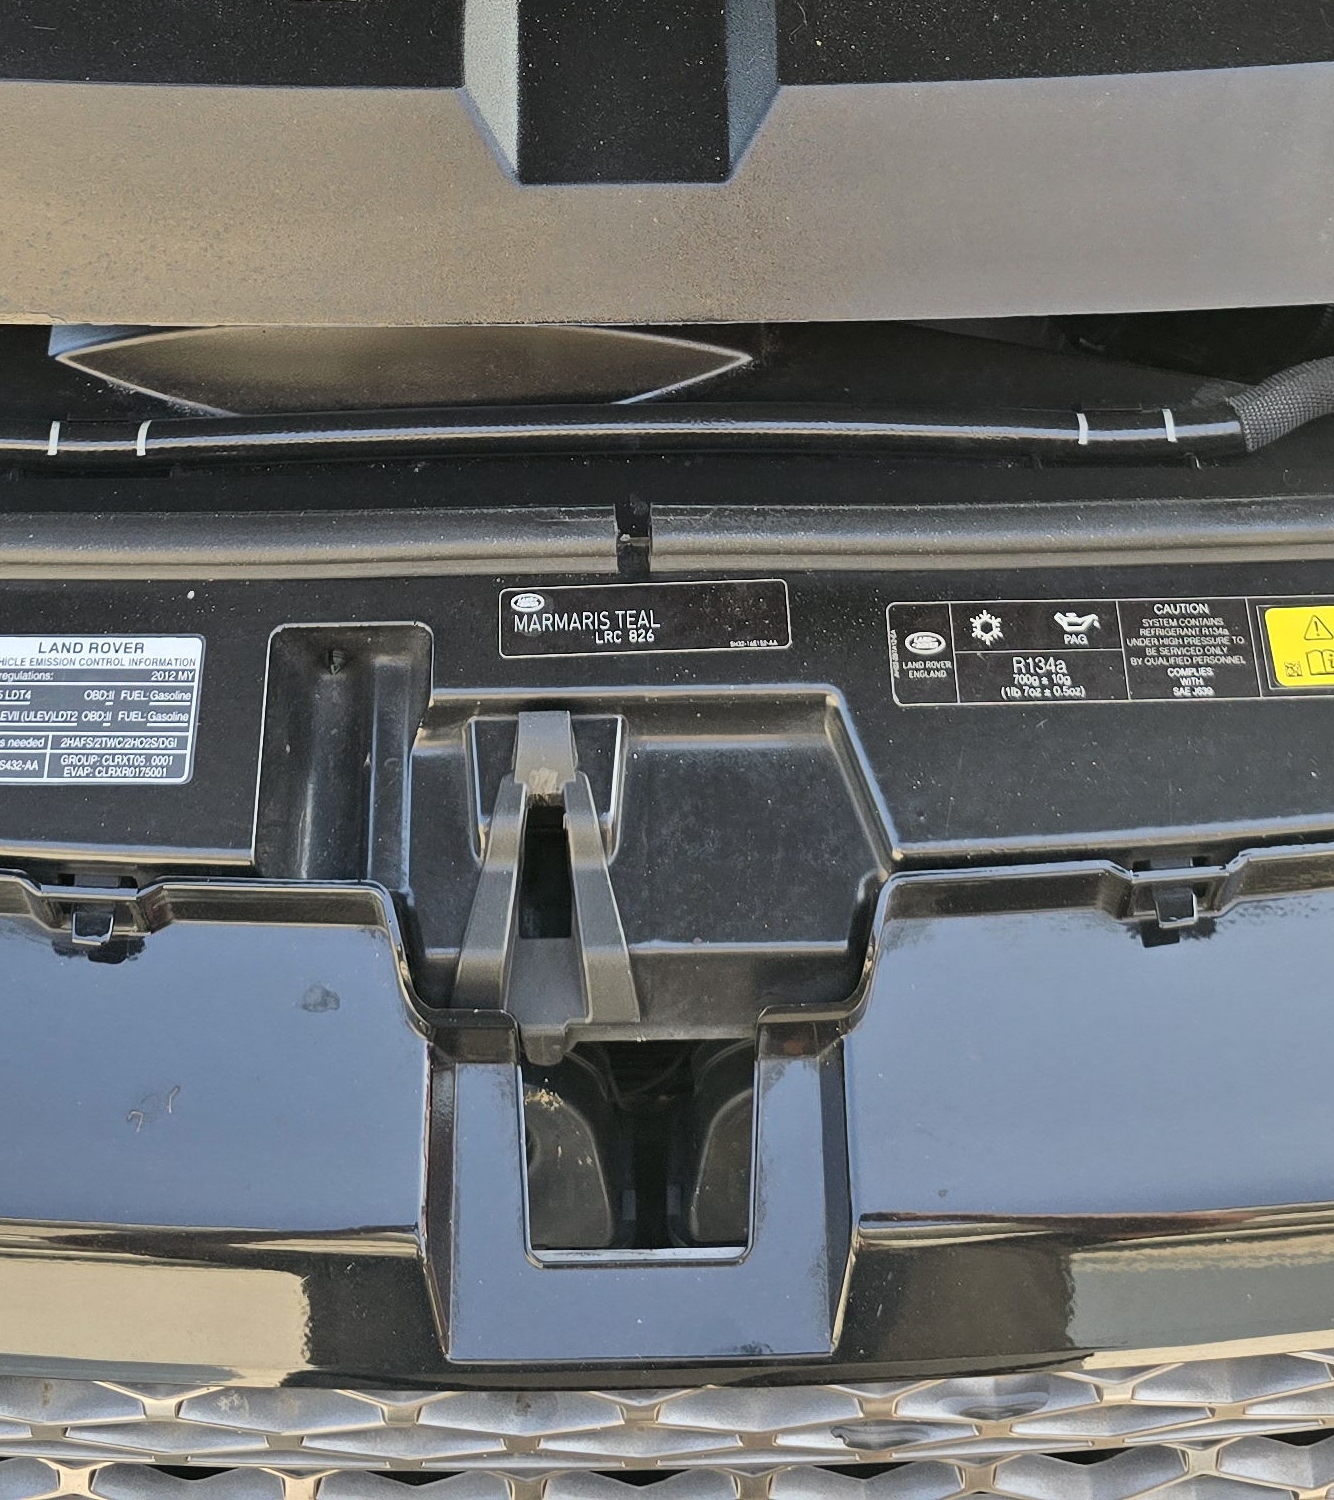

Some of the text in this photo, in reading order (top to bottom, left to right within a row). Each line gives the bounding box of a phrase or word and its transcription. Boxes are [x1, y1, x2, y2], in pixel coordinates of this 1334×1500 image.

[1154, 603, 1210, 615] CAUTION
[514, 609, 661, 632] MARMARIS TEAL
[1142, 618, 1224, 627] SYSTEM CONTAINS
[595, 629, 655, 644] LRC 826
[1140, 627, 1200, 636] REFRIGERANT
[1064, 634, 1089, 645] PAG
[1127, 636, 1245, 646] UNDER HIGH PRESSURE TO
[38, 642, 144, 654] LAND ROVER
[1146, 646, 1228, 655] BE SERVICED ONLY
[29, 657, 76, 666] EMISSION
[78, 657, 125, 667] CONTROL
[128, 657, 196, 667] INFORMATION
[903, 660, 952, 669] LAND ROVER
[1012, 657, 1068, 674] R134a
[1130, 656, 1246, 666] BY QUALIFIED PERSONNEL
[151, 671, 194, 681] 2012 MY
[909, 670, 947, 678] ENGLAND
[1167, 667, 1214, 677] COMPLIES
[1013, 674, 1039, 687] 700g
[1052, 674, 1072, 686] 10g
[1180, 677, 1204, 686] WITH
[5, 690, 32, 700] LDT4
[150, 690, 191, 700] Gasoline
[1024, 687, 1042, 697] 7oz
[1173, 687, 1191, 696] SAE
[148, 710, 189, 722] Gasoline
[7, 737, 45, 747] needed
[61, 754, 101, 766] GROUP:
[63, 767, 94, 777] EVAP:
